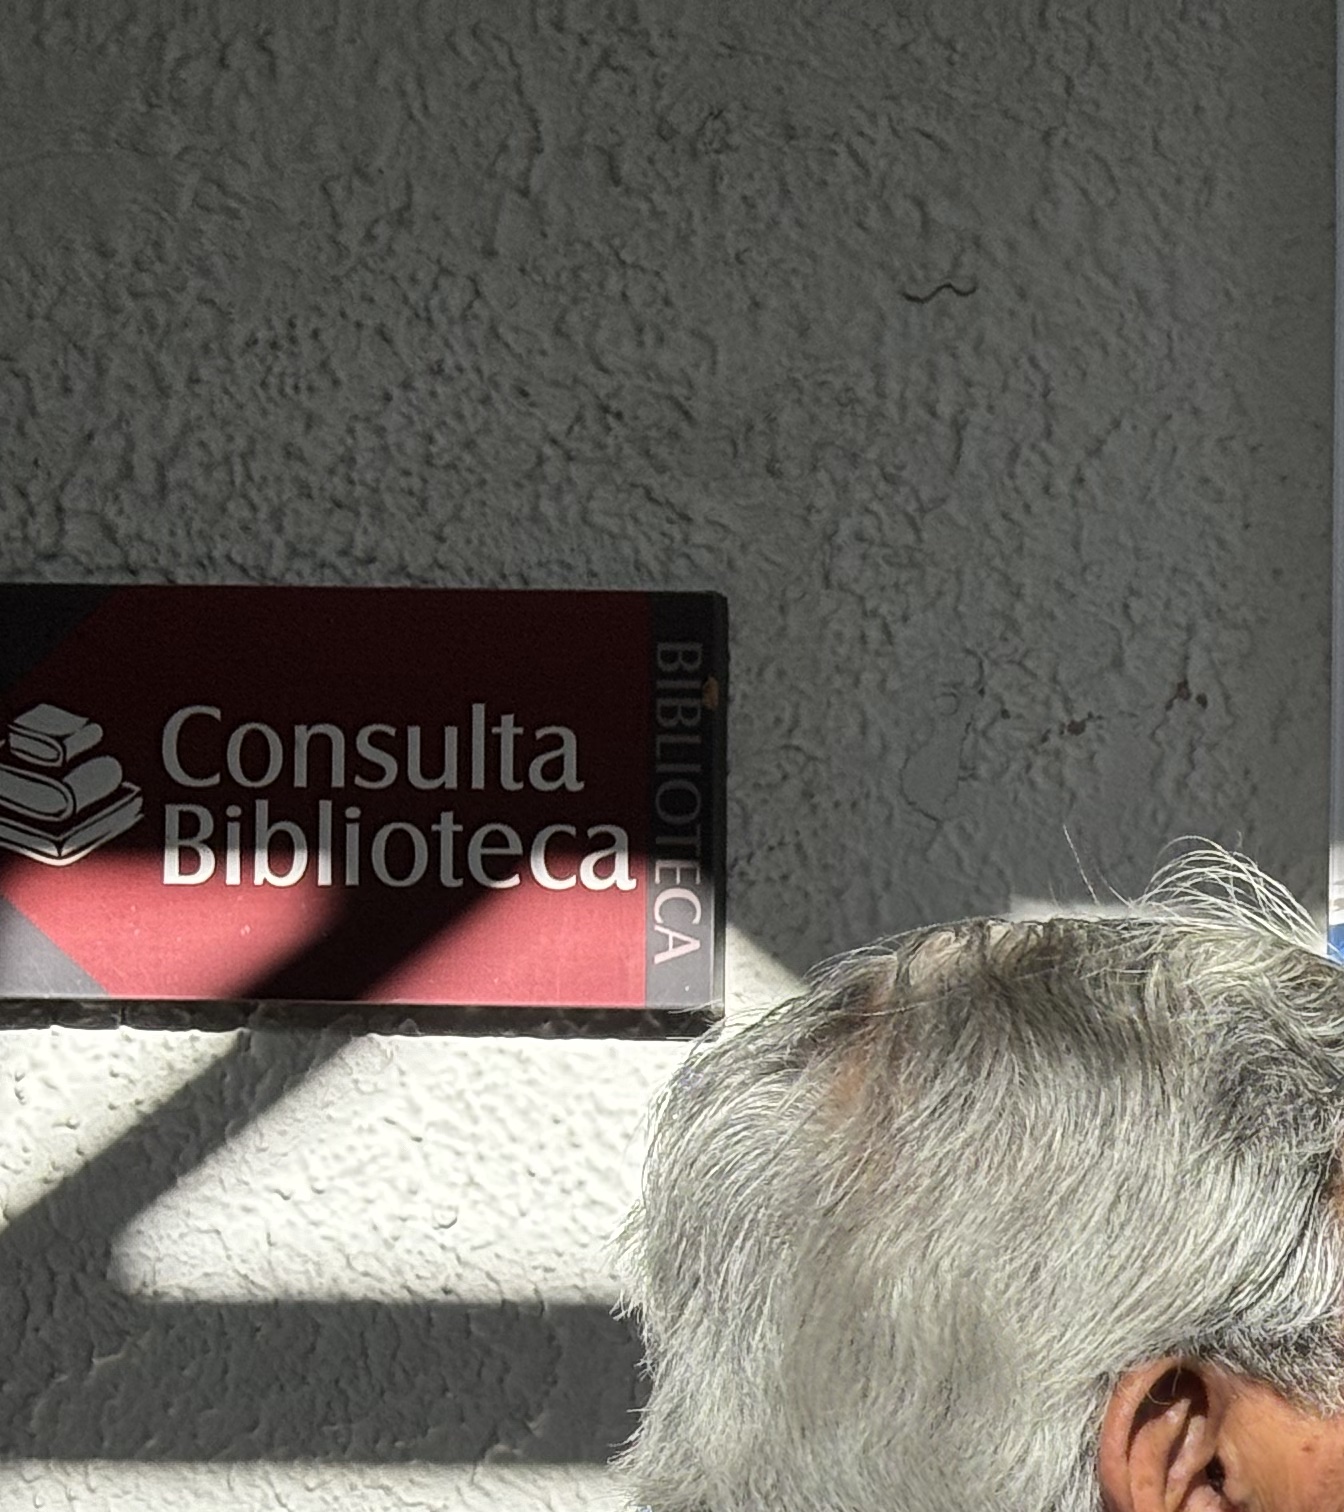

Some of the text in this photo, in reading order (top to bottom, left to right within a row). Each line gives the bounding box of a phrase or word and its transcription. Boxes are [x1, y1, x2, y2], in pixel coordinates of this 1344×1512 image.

[162, 703, 584, 792] Consulta
[162, 800, 637, 891] Biblioteca
[653, 642, 701, 965] BIBLIOTECA
